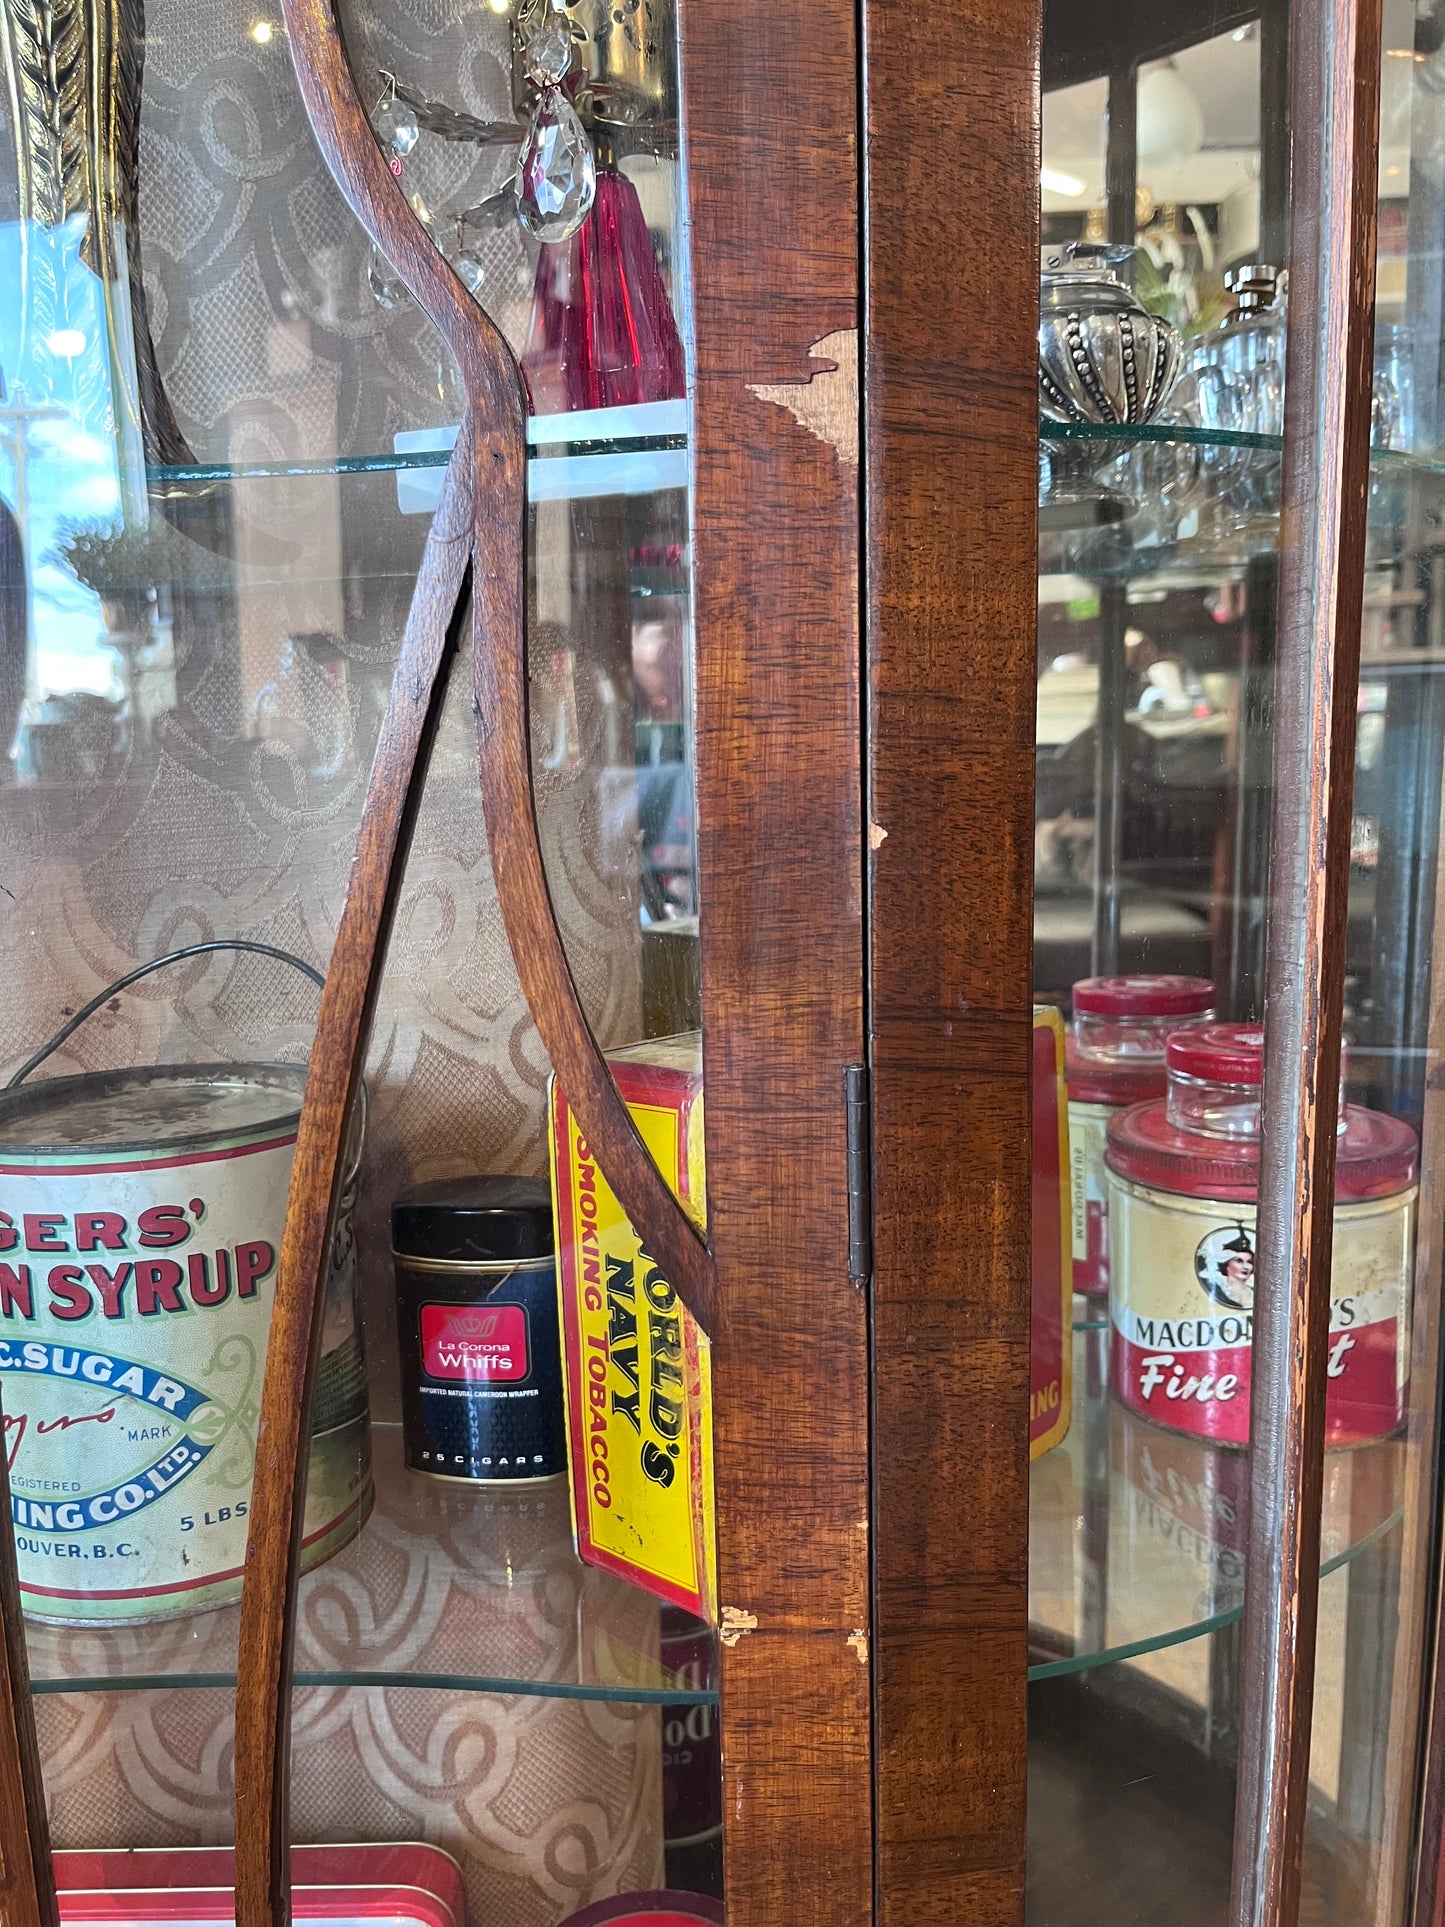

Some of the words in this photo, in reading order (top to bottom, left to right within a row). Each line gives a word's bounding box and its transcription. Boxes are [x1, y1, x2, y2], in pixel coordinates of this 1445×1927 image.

[577, 1135, 602, 1312] SMOKING
[48, 1240, 276, 1321] SYRUP
[438, 1340, 455, 1350] La
[458, 1341, 511, 1352] Corona
[438, 1352, 513, 1370] Whiffs
[605, 1253, 642, 1437] NAVY
[634, 1228, 685, 1489] ORLD'S
[23, 1342, 186, 1411] SUGAR
[419, 1386, 447, 1396] IMPORTED
[448, 1389, 473, 1398] NATURAL
[474, 1390, 508, 1398] CAMEROON
[509, 1389, 539, 1398] WRAPPER
[1139, 1354, 1238, 1401] Fine
[128, 1424, 172, 1442] MARK
[587, 1330, 612, 1509] TOBACCO
[455, 1454, 544, 1465] CIGARS
[11, 1496, 84, 1530] ING
[89, 1482, 155, 1521] CO.
[146, 1445, 202, 1492] LTD.
[180, 1515, 195, 1531] 5
[204, 1501, 248, 1526] LBS
[93, 1542, 141, 1559] B.C.
